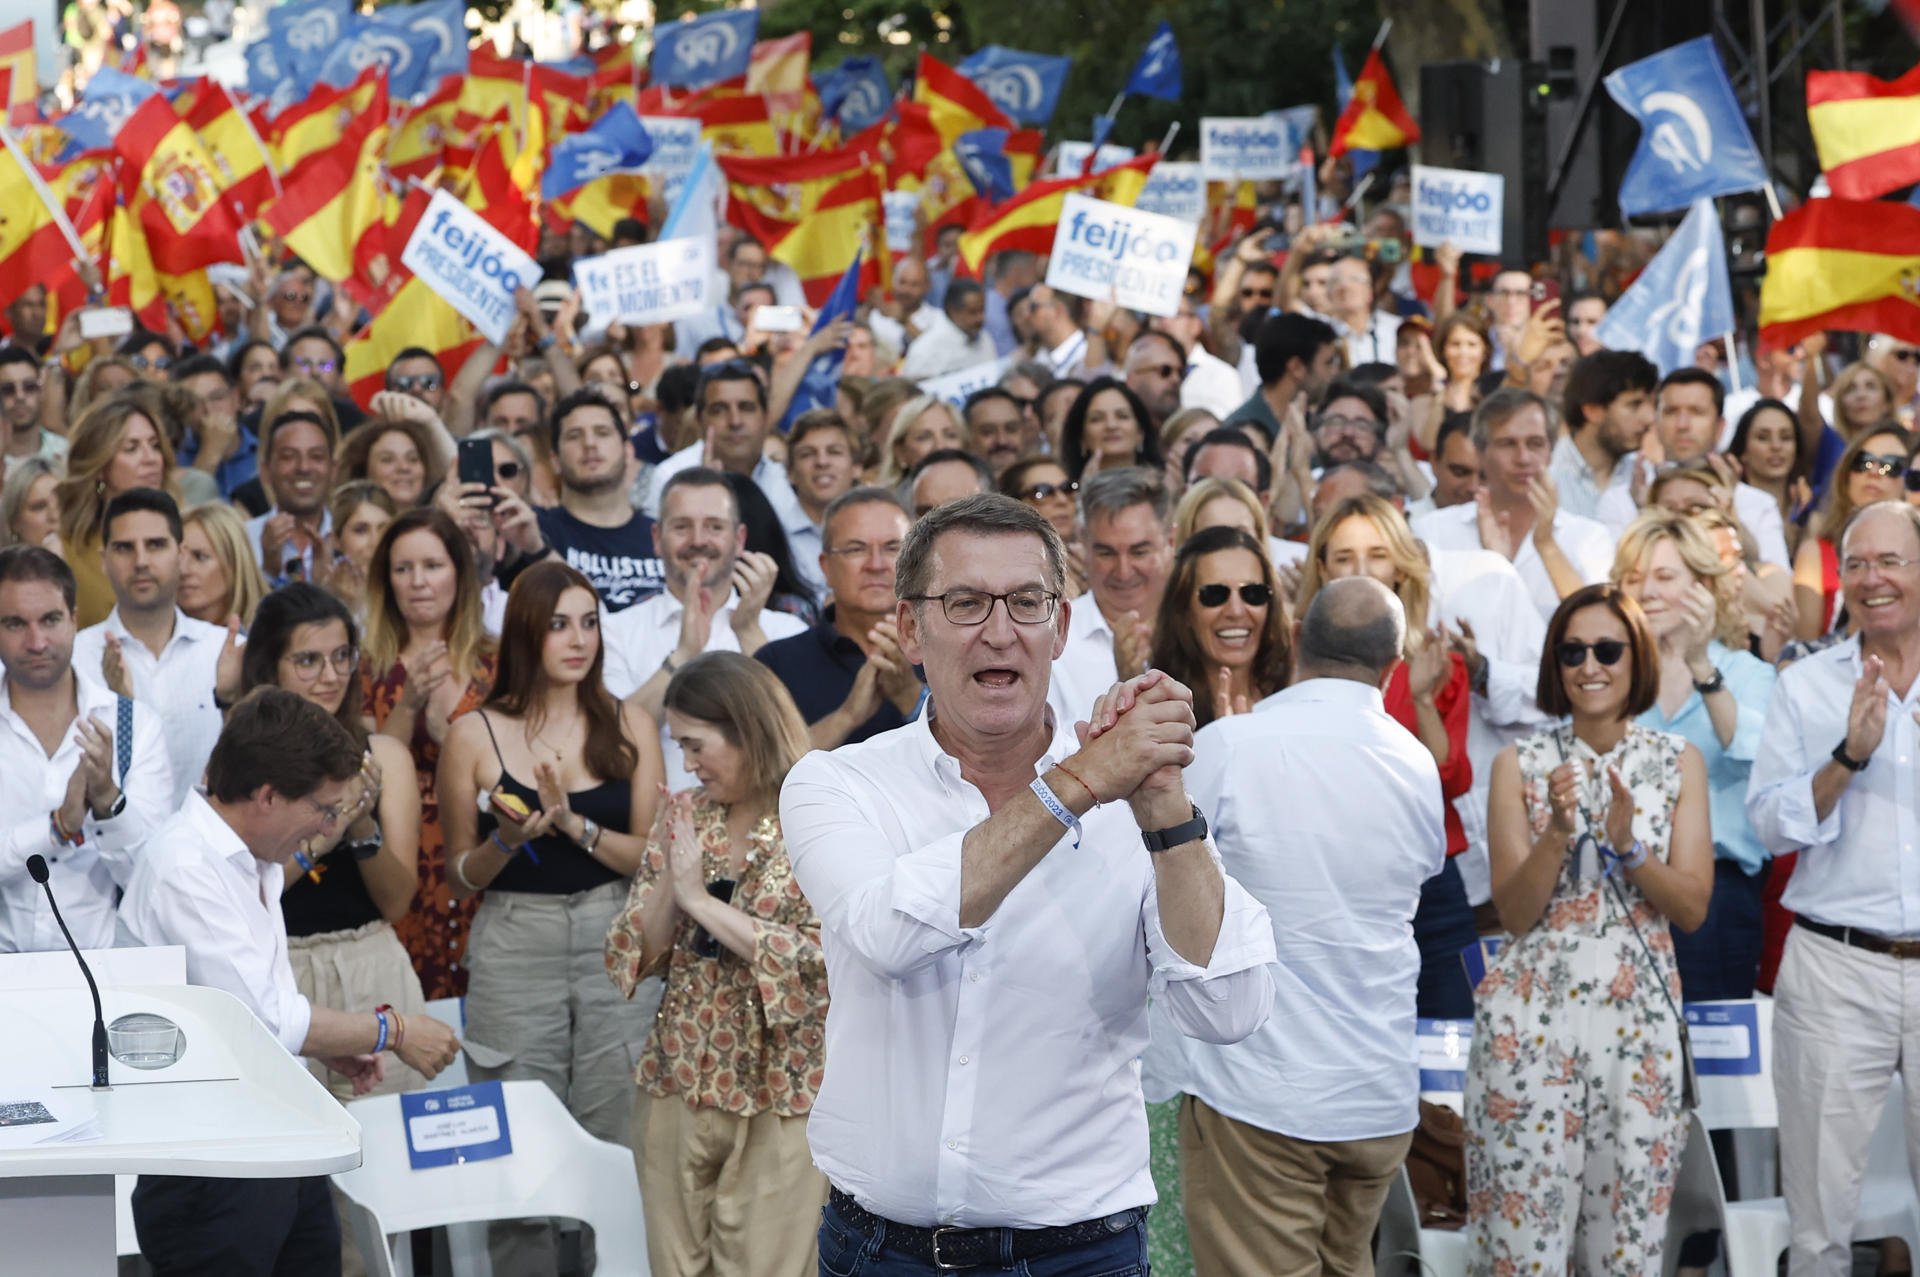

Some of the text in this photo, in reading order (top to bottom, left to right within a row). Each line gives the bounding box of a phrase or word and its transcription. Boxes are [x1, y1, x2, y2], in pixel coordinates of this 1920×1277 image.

[431, 210, 520, 293] feijóo
[1070, 210, 1179, 263] feijóo
[1045, 796, 1064, 817] 2023
